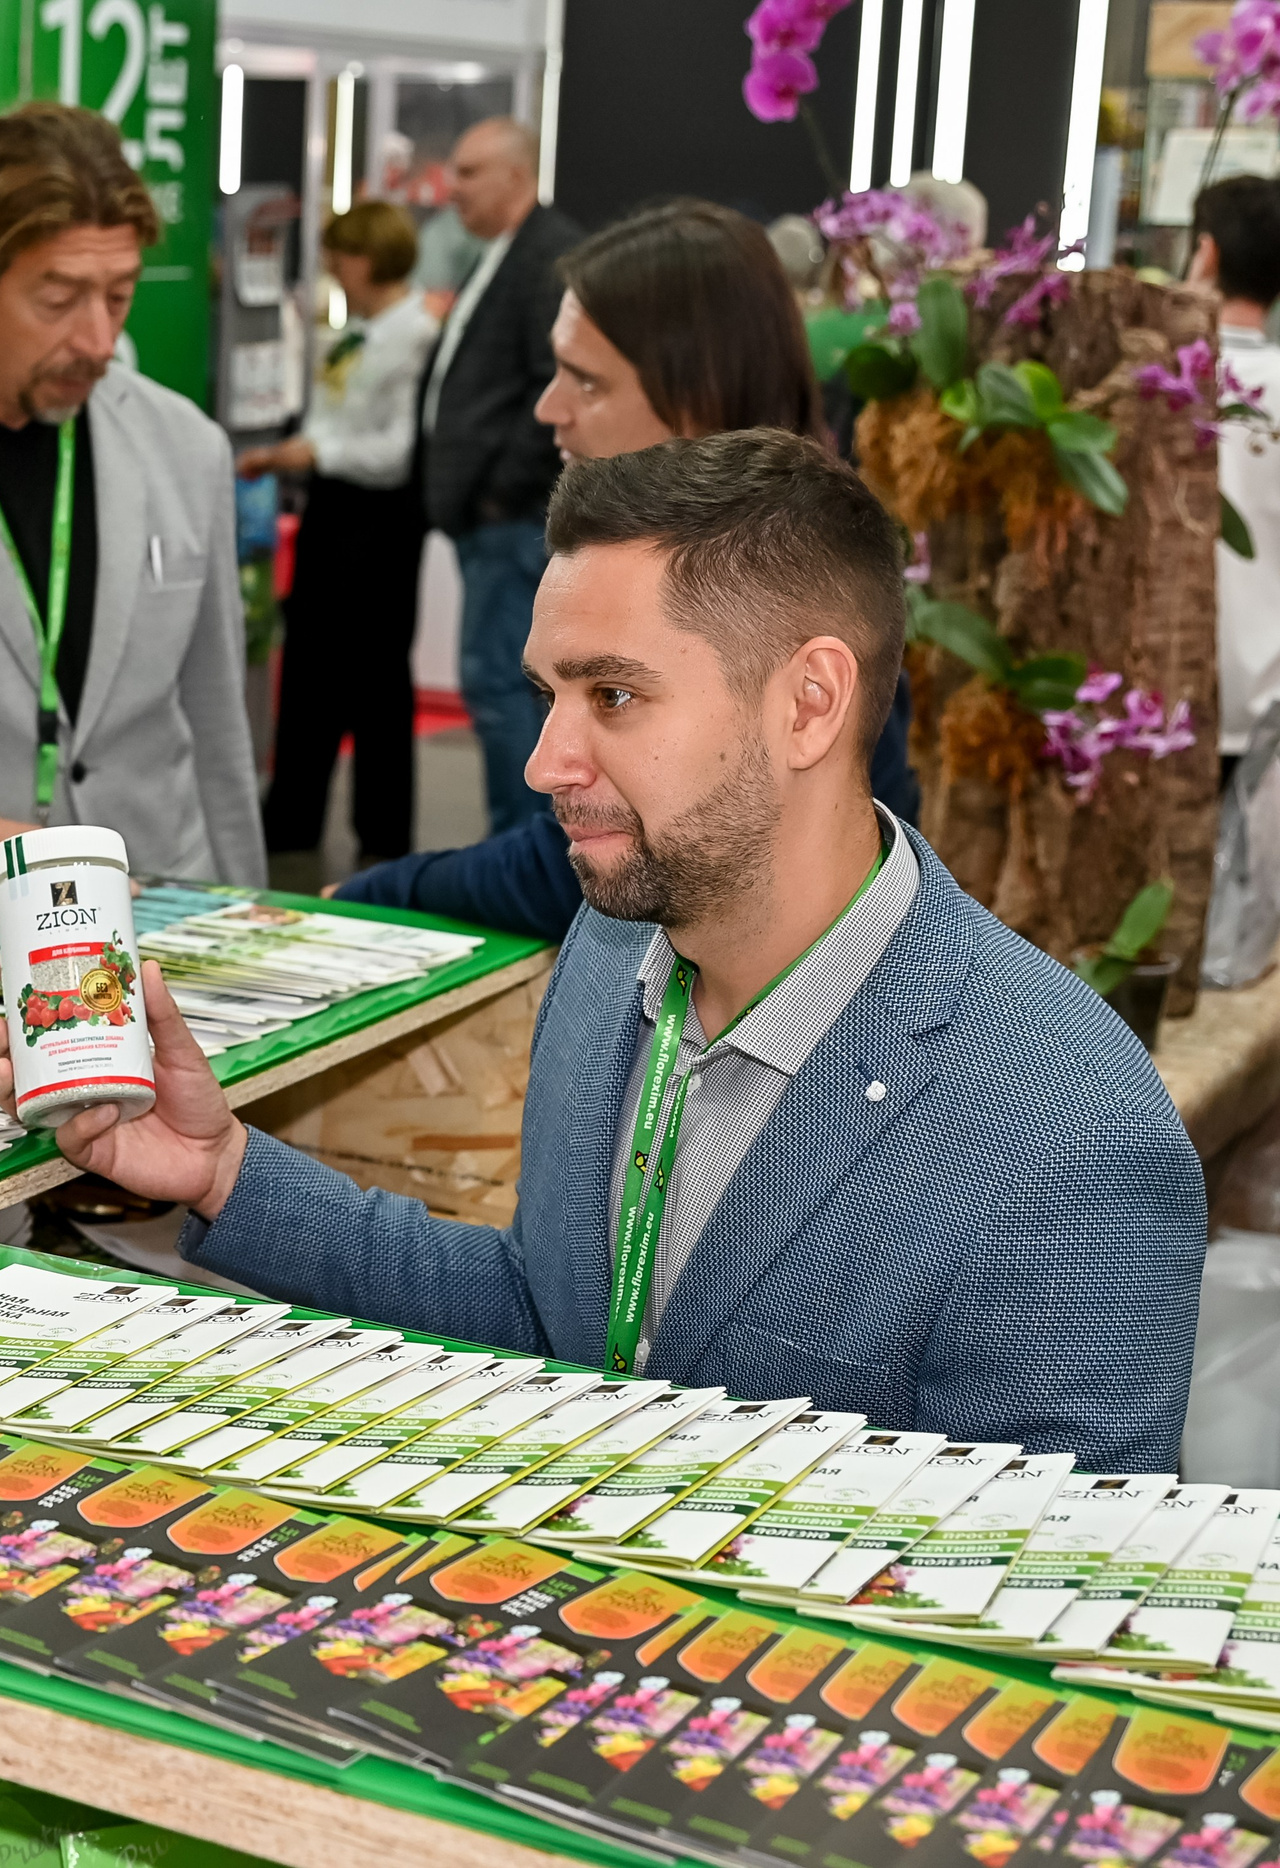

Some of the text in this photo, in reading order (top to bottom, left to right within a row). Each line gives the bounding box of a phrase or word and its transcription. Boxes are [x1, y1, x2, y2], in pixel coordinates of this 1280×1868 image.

[36, 908, 97, 931] ZION
[643, 1014, 677, 1130] www.florexim.eu
[625, 1212, 655, 1323] www.florexim.eu
[73, 1292, 144, 1304] ZION
[2, 1338, 55, 1348] ПРОСТО
[77, 1381, 132, 1389] ОЛЕЗНО
[640, 1464, 699, 1473] ПРОСТО
[1058, 1489, 1144, 1500] ZION
[673, 1502, 736, 1512] ОЛЕЗНО
[792, 1503, 856, 1513] ПРОСТО
[753, 1526, 831, 1540] ПОЛЕЗНО
[942, 1531, 1009, 1541] ПРОСТО
[911, 1557, 992, 1567] ПОЛЕЗНО
[1145, 1598, 1219, 1609] ОЛЕЗНО
